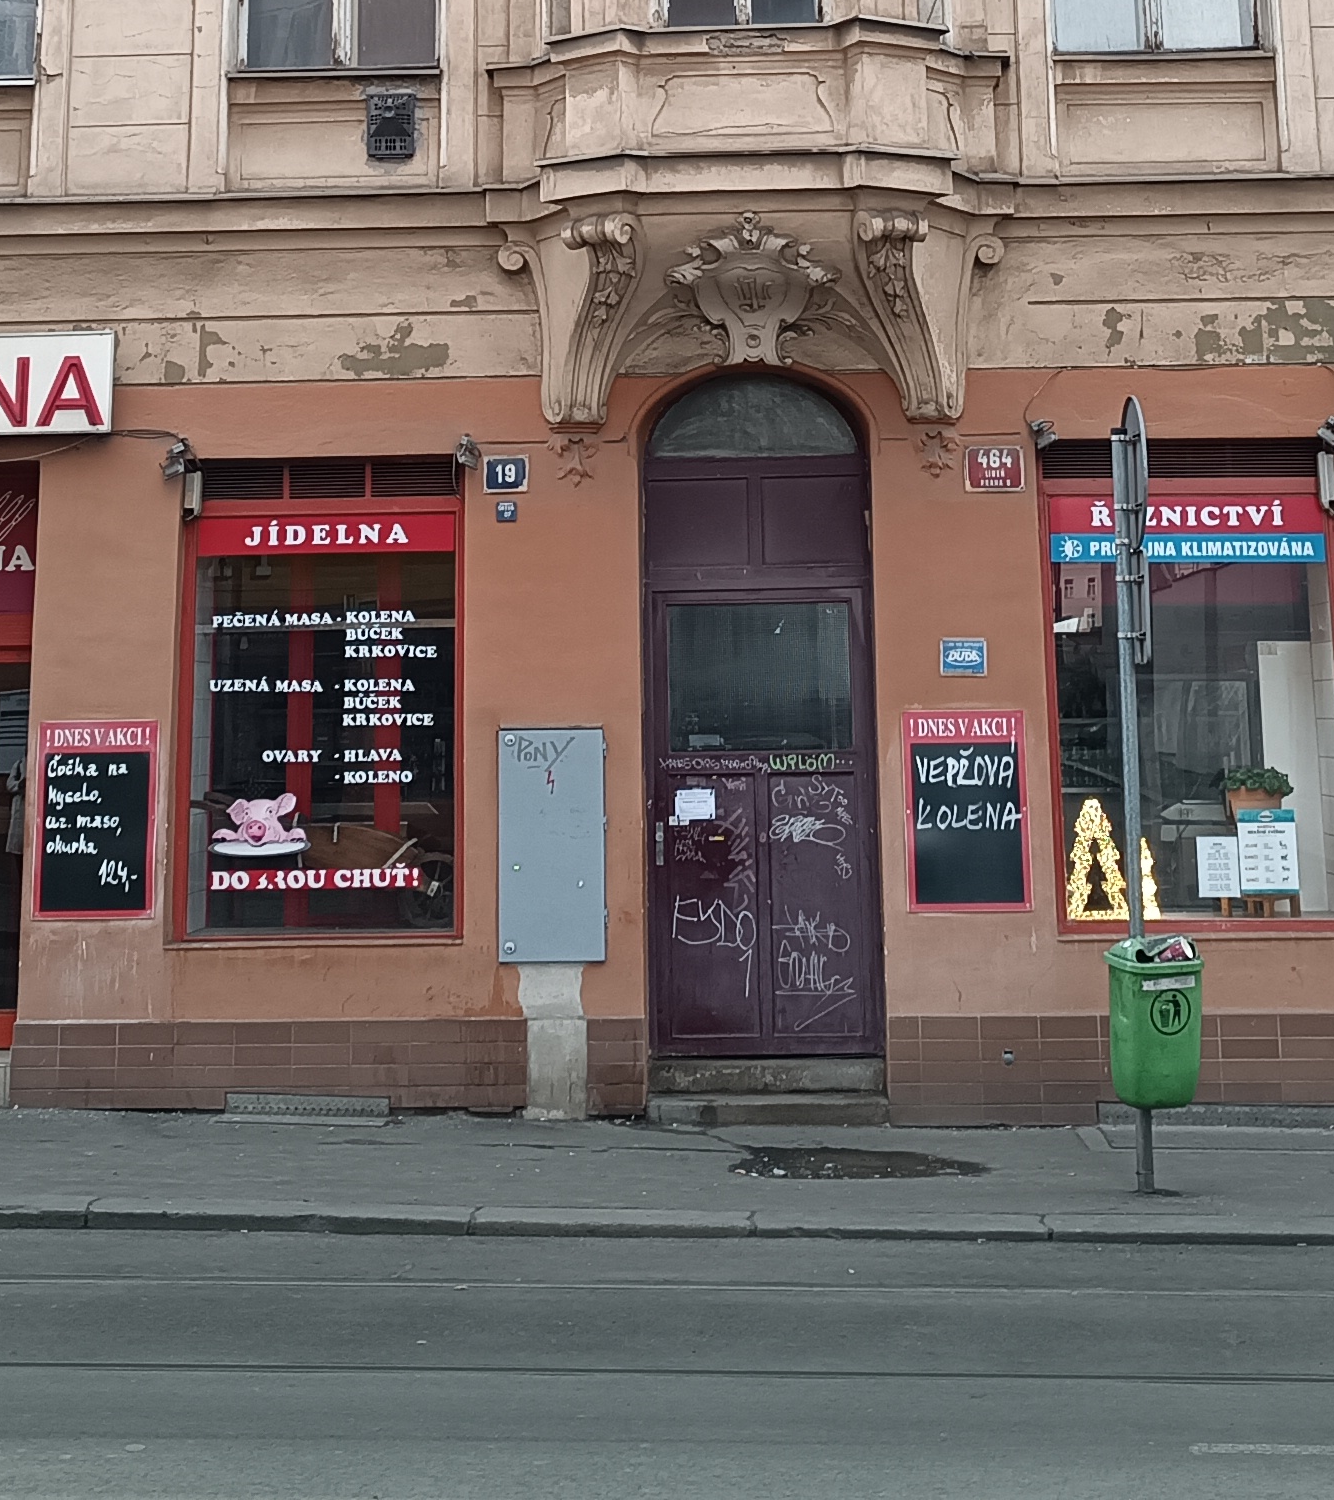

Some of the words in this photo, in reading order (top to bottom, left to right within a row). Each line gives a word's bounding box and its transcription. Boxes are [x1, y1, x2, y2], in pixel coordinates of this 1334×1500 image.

[977, 449, 1013, 468] 464
[495, 463, 516, 484] 19
[1090, 500, 1284, 527] ŘZNICTVÍ
[244, 520, 409, 546] JÍDELNA
[1181, 538, 1315, 557] KLIMATIZOVÁNA
[212, 608, 281, 628] PEČENÁ
[284, 612, 333, 627] MASA
[345, 610, 416, 624] KOLENA
[345, 624, 404, 641] BŮČEK
[344, 645, 438, 658] KRKOVICE
[947, 650, 980, 662] DUDA
[209, 676, 270, 692] UZENÁ
[275, 679, 323, 692] MASA
[343, 679, 416, 692] KOLENA
[343, 693, 402, 710] BŮČEK
[342, 713, 435, 727] KRKOVICE
[917, 718, 956, 737] DNES
[958, 718, 969, 736] V
[970, 718, 1007, 736] AKCI
[53, 728, 91, 747] DNES
[94, 728, 105, 746] V
[105, 728, 143, 746] AKCI
[261, 750, 322, 763] OVARY
[343, 748, 403, 762] HLAVA
[915, 736, 1015, 789] VEPŘOVÁ
[47, 753, 99, 778] Čočka
[107, 762, 129, 777] na
[343, 770, 413, 784] KOLENO
[916, 798, 1023, 831] KOLENA
[76, 814, 122, 837] maso,
[45, 832, 99, 855] okurka
[334, 862, 419, 888] CHUŤ!
